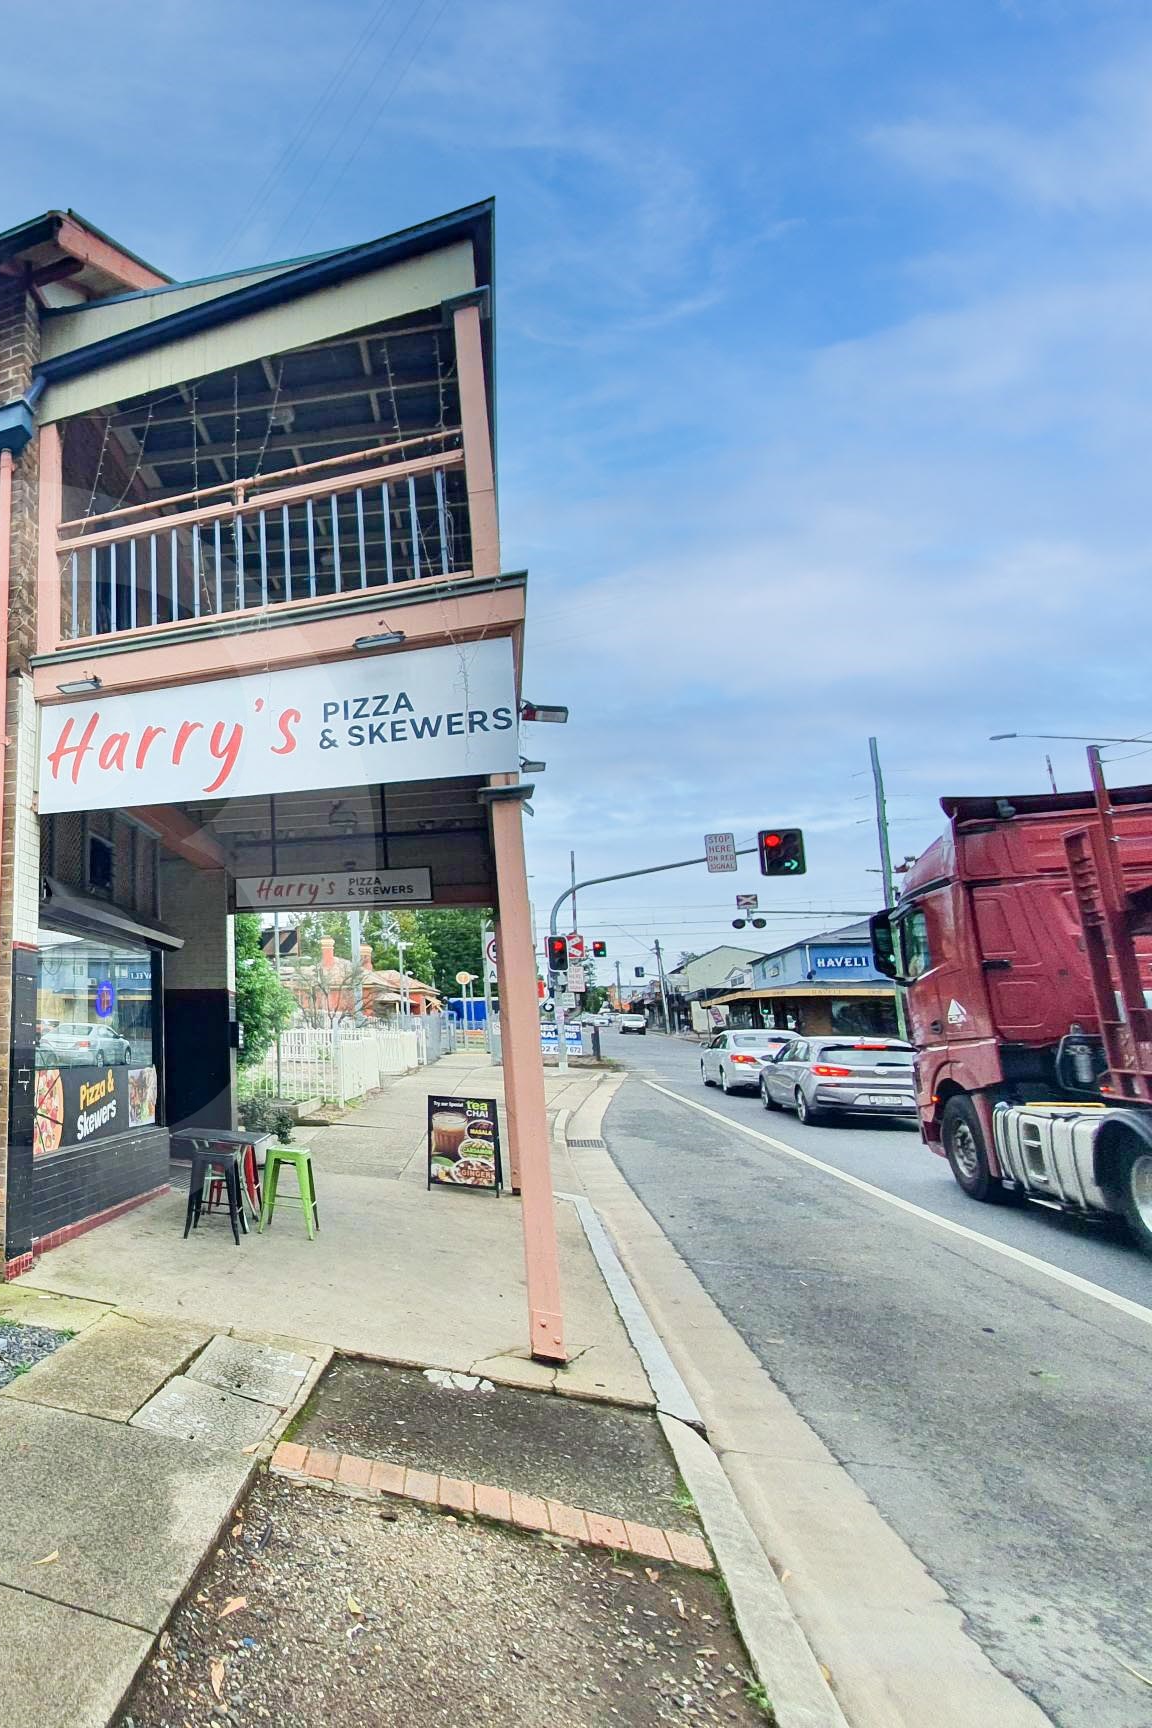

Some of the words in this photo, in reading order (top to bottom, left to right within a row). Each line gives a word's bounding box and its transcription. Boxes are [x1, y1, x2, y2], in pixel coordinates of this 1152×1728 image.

[322, 691, 415, 723] PIZZA
[318, 727, 339, 750] &
[347, 706, 514, 748] SKEWERS
[47, 697, 302, 793] Harry's
[708, 835, 731, 843] STOP
[708, 845, 733, 853] HERE
[349, 877, 382, 887] PIZZA
[256, 877, 336, 904] Harry's
[347, 888, 354, 896] &
[358, 885, 415, 895] SKEWERS
[816, 956, 867, 968] HAVELI
[79, 1081, 106, 1111] Pizza
[107, 1068, 115, 1093] &
[466, 1101, 488, 1111] tea
[76, 1099, 117, 1141] Skewers
[470, 1128, 493, 1136] MASALA
[461, 1168, 492, 1178] GINGER
